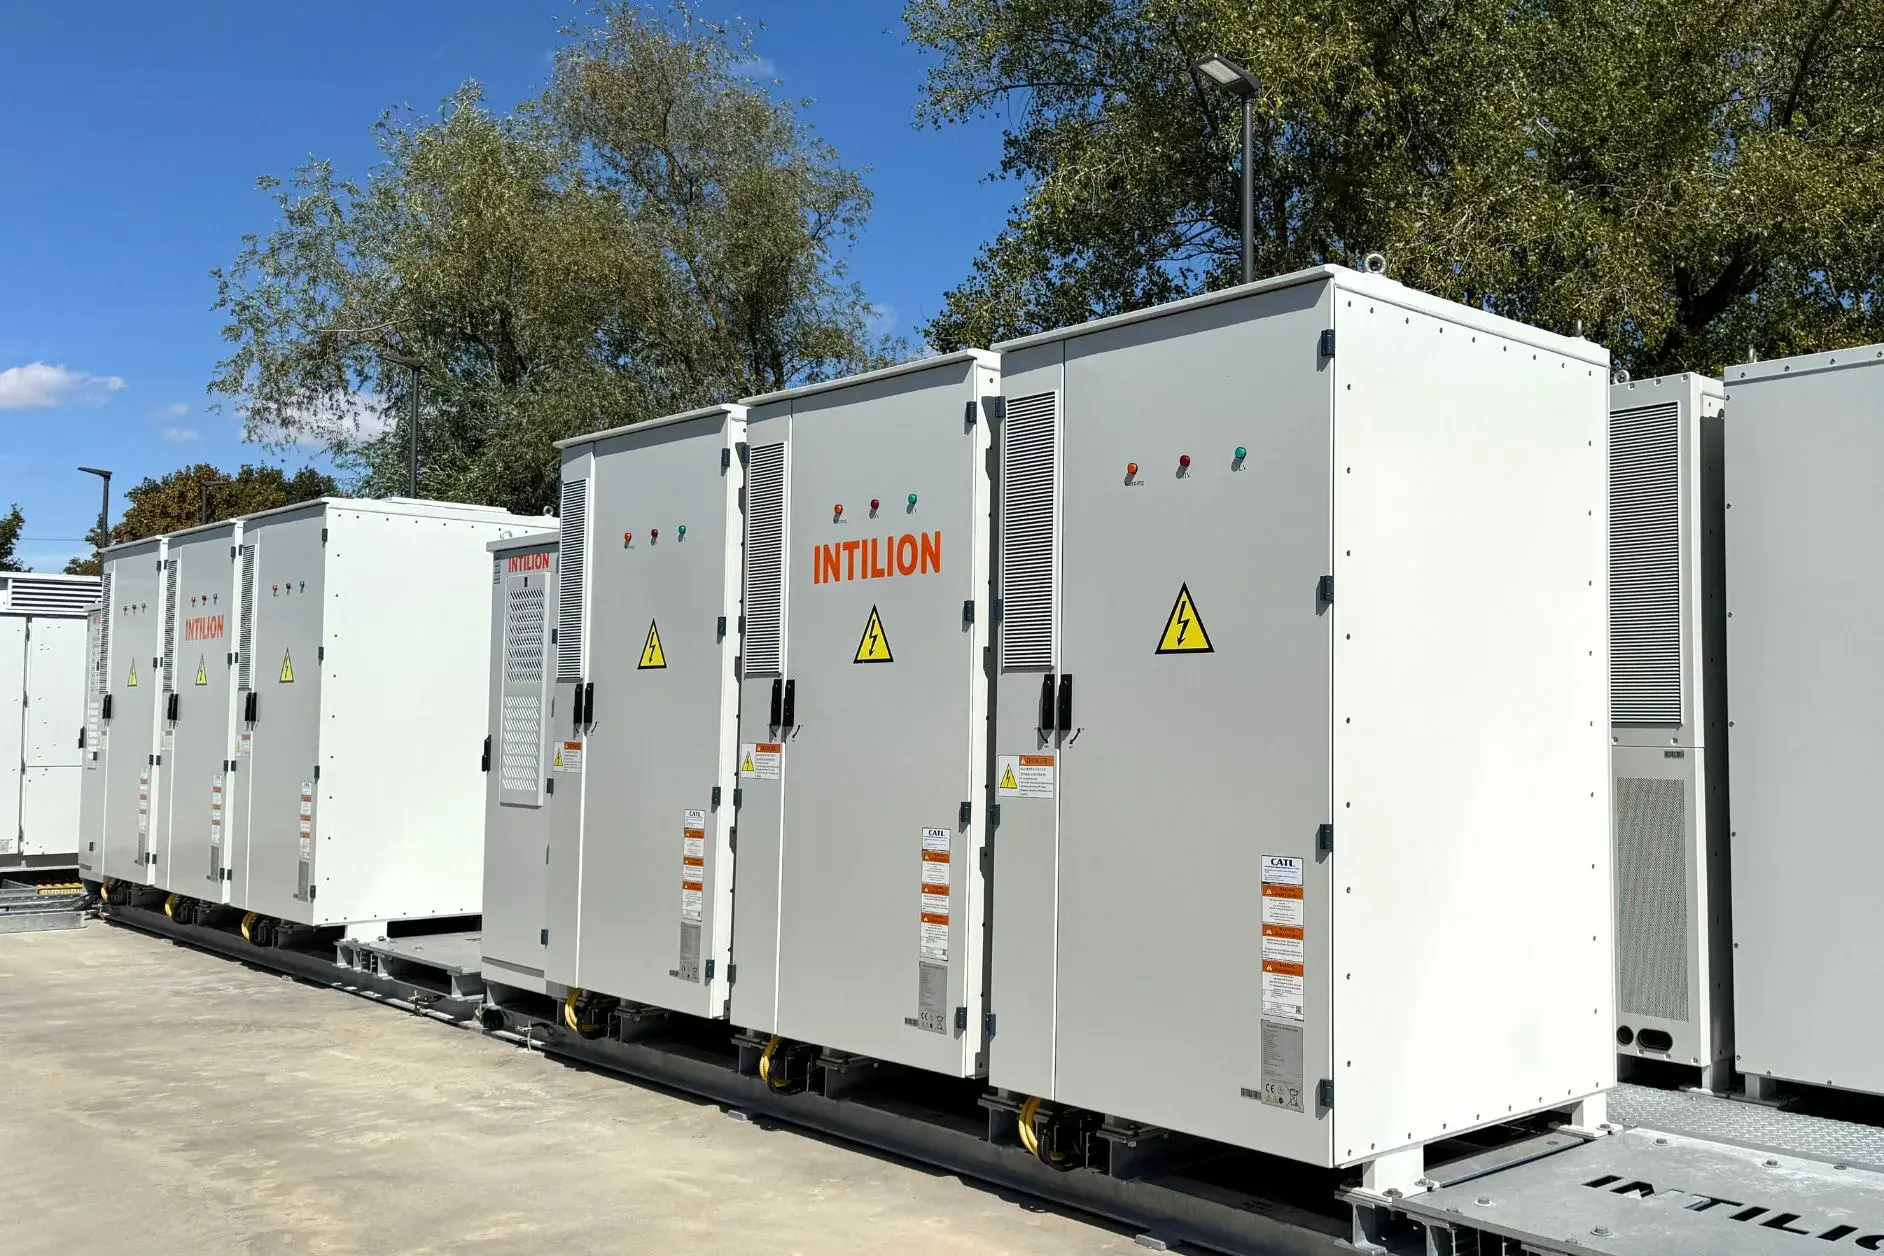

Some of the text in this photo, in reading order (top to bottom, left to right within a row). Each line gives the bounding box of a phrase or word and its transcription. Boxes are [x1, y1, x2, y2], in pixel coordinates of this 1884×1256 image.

[508, 552, 550, 573] INTILION
[813, 530, 941, 585] INTILION
[185, 614, 225, 641] INTILION
[928, 829, 945, 837] CATL
[1270, 858, 1293, 867] CATL
